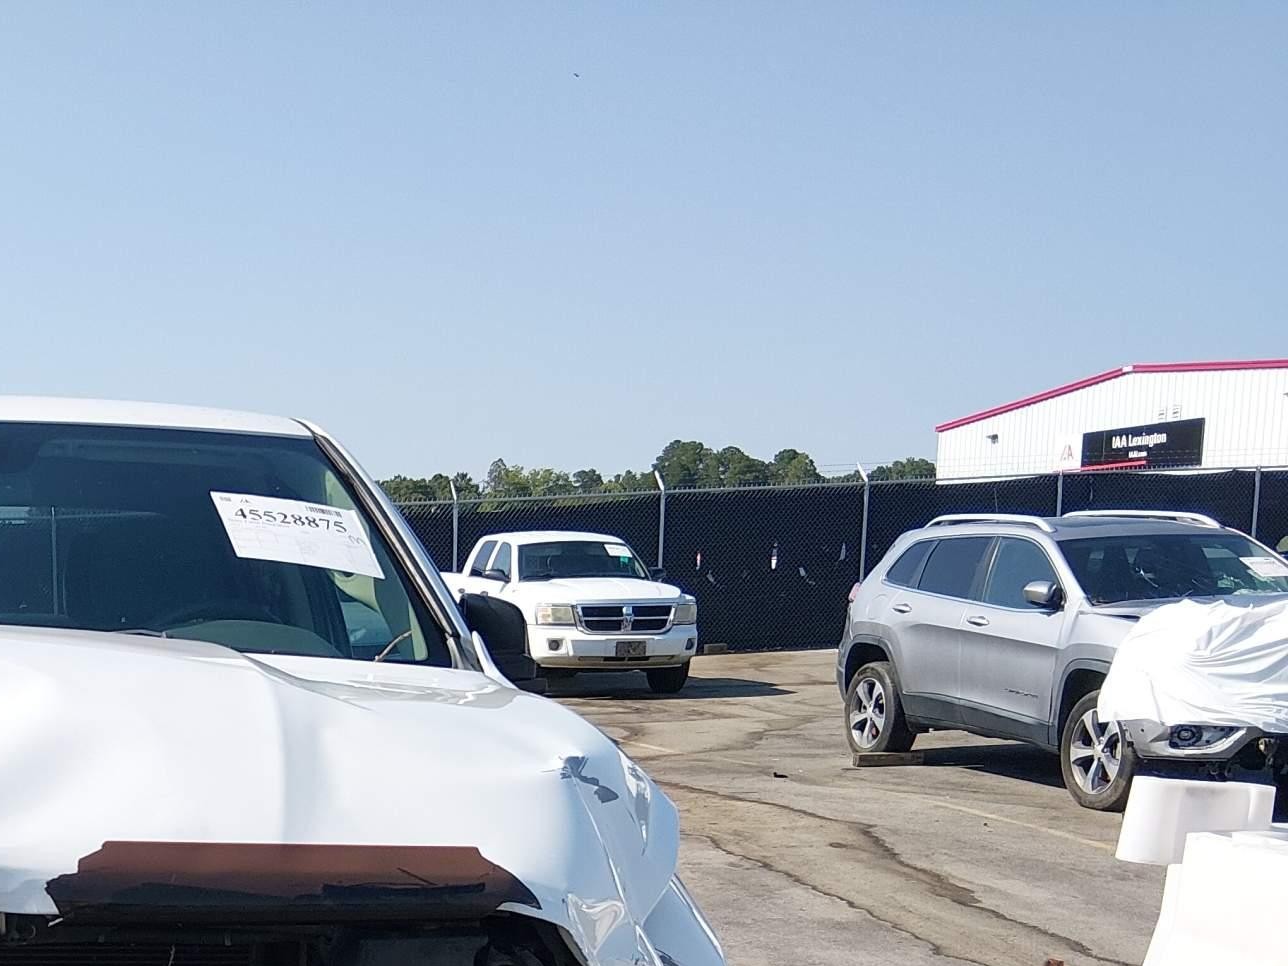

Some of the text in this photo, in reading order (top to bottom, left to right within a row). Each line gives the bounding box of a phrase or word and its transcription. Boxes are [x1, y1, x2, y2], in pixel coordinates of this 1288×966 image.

[1112, 432, 1167, 448] IAA Lexington
[234, 507, 348, 533] 45528875
